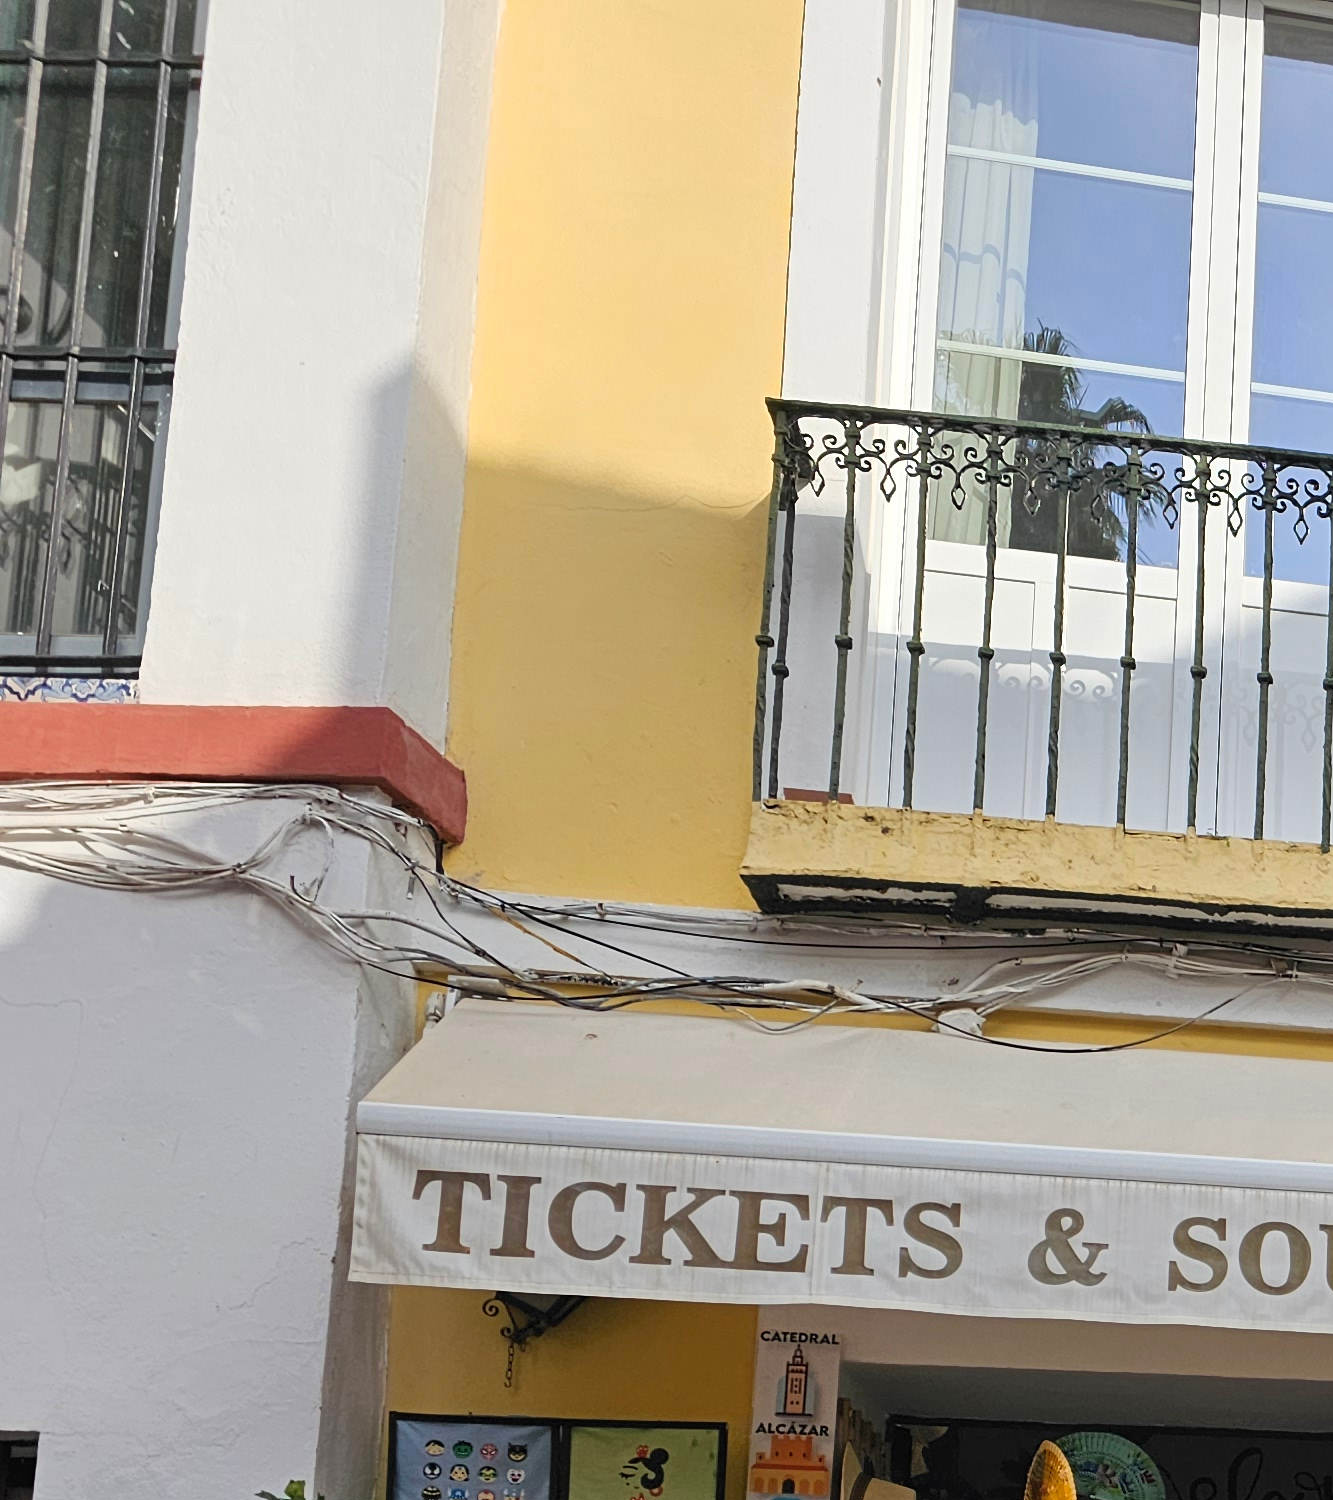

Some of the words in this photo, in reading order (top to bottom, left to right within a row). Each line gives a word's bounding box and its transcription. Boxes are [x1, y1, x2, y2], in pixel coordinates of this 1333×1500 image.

[411, 1168, 965, 1280] TICKETS
[1027, 1207, 1109, 1287] &
[760, 1330, 840, 1345] CATEDRAL
[755, 1421, 829, 1437] ALCÁZAR
